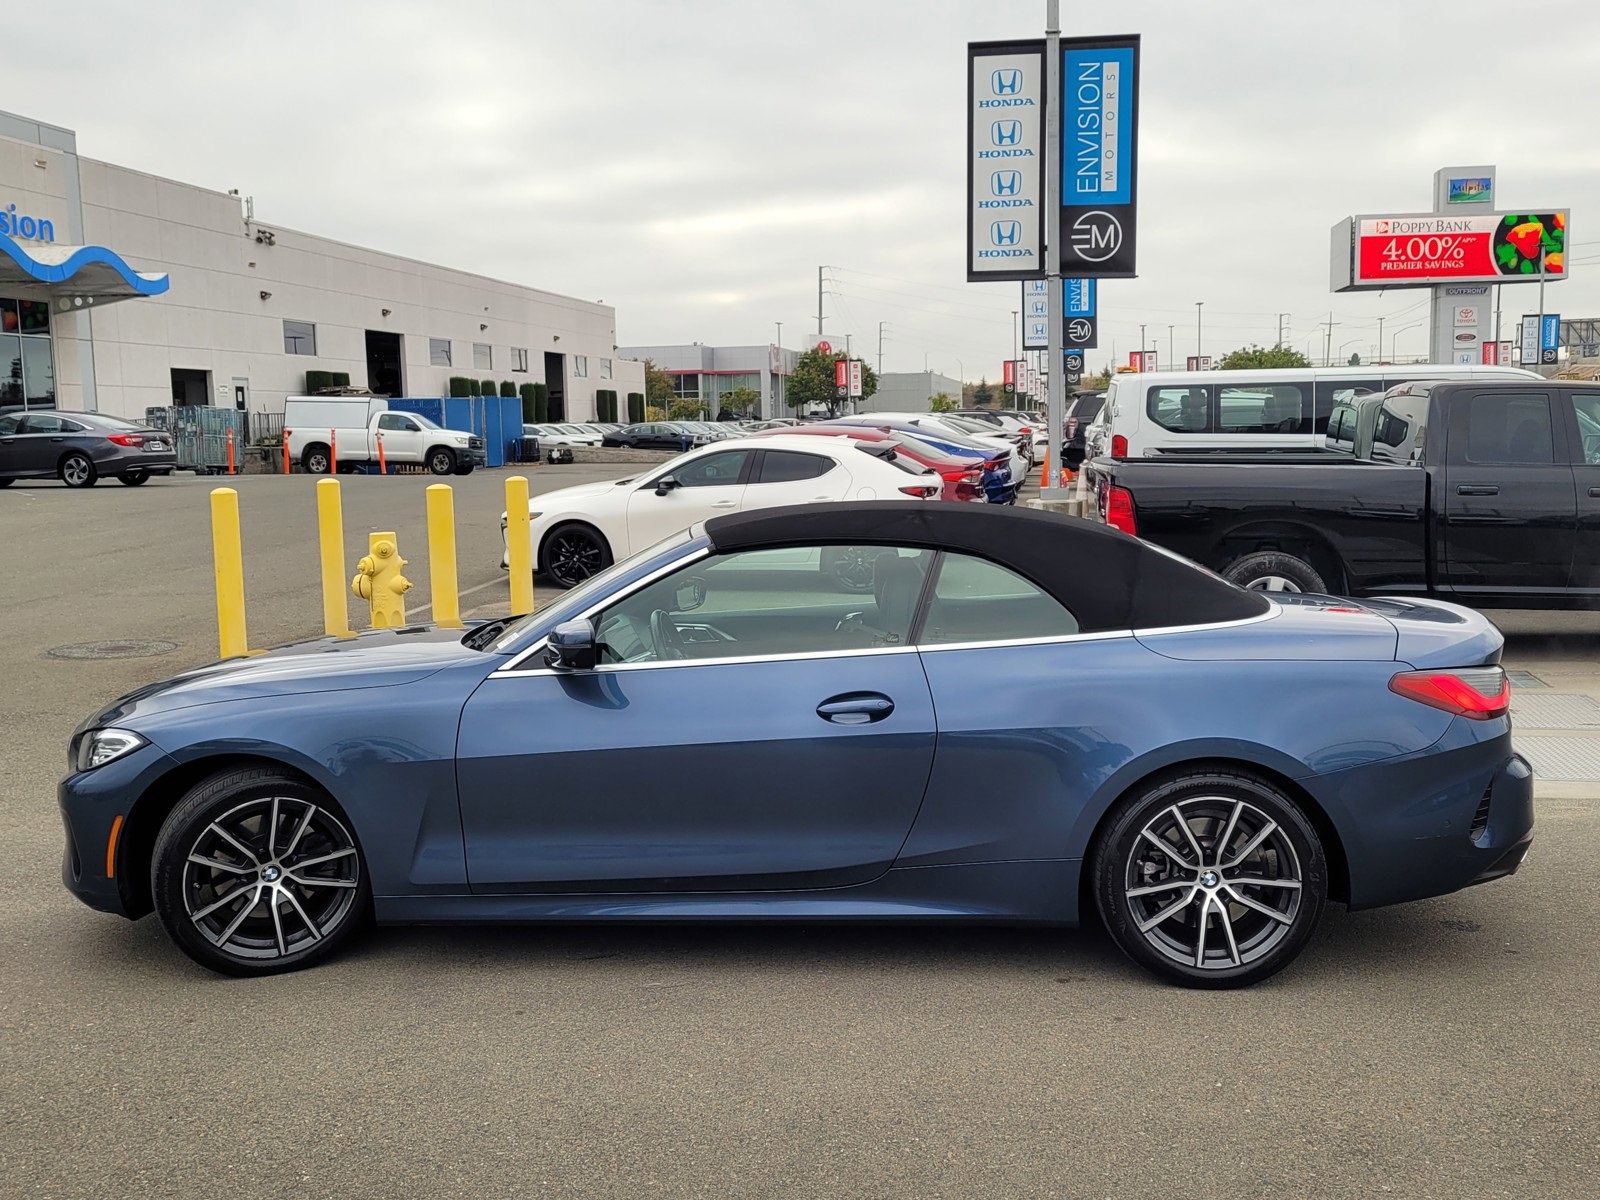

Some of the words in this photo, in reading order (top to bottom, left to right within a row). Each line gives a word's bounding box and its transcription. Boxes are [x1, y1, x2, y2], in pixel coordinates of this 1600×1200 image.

[978, 97, 1035, 108] HONDA
[1077, 62, 1101, 193] ENVISION
[1105, 73, 1116, 181] MOTORS
[978, 148, 1035, 158] HONDA
[978, 198, 1035, 208] HONDA
[1392, 221, 1433, 233] POPPY
[1436, 220, 1472, 232] BANK
[978, 248, 1035, 258] HONDA
[1382, 236, 1464, 260] 4.00%
[1381, 261, 1422, 270] PREMIER
[1425, 260, 1464, 269] SAVINGS
